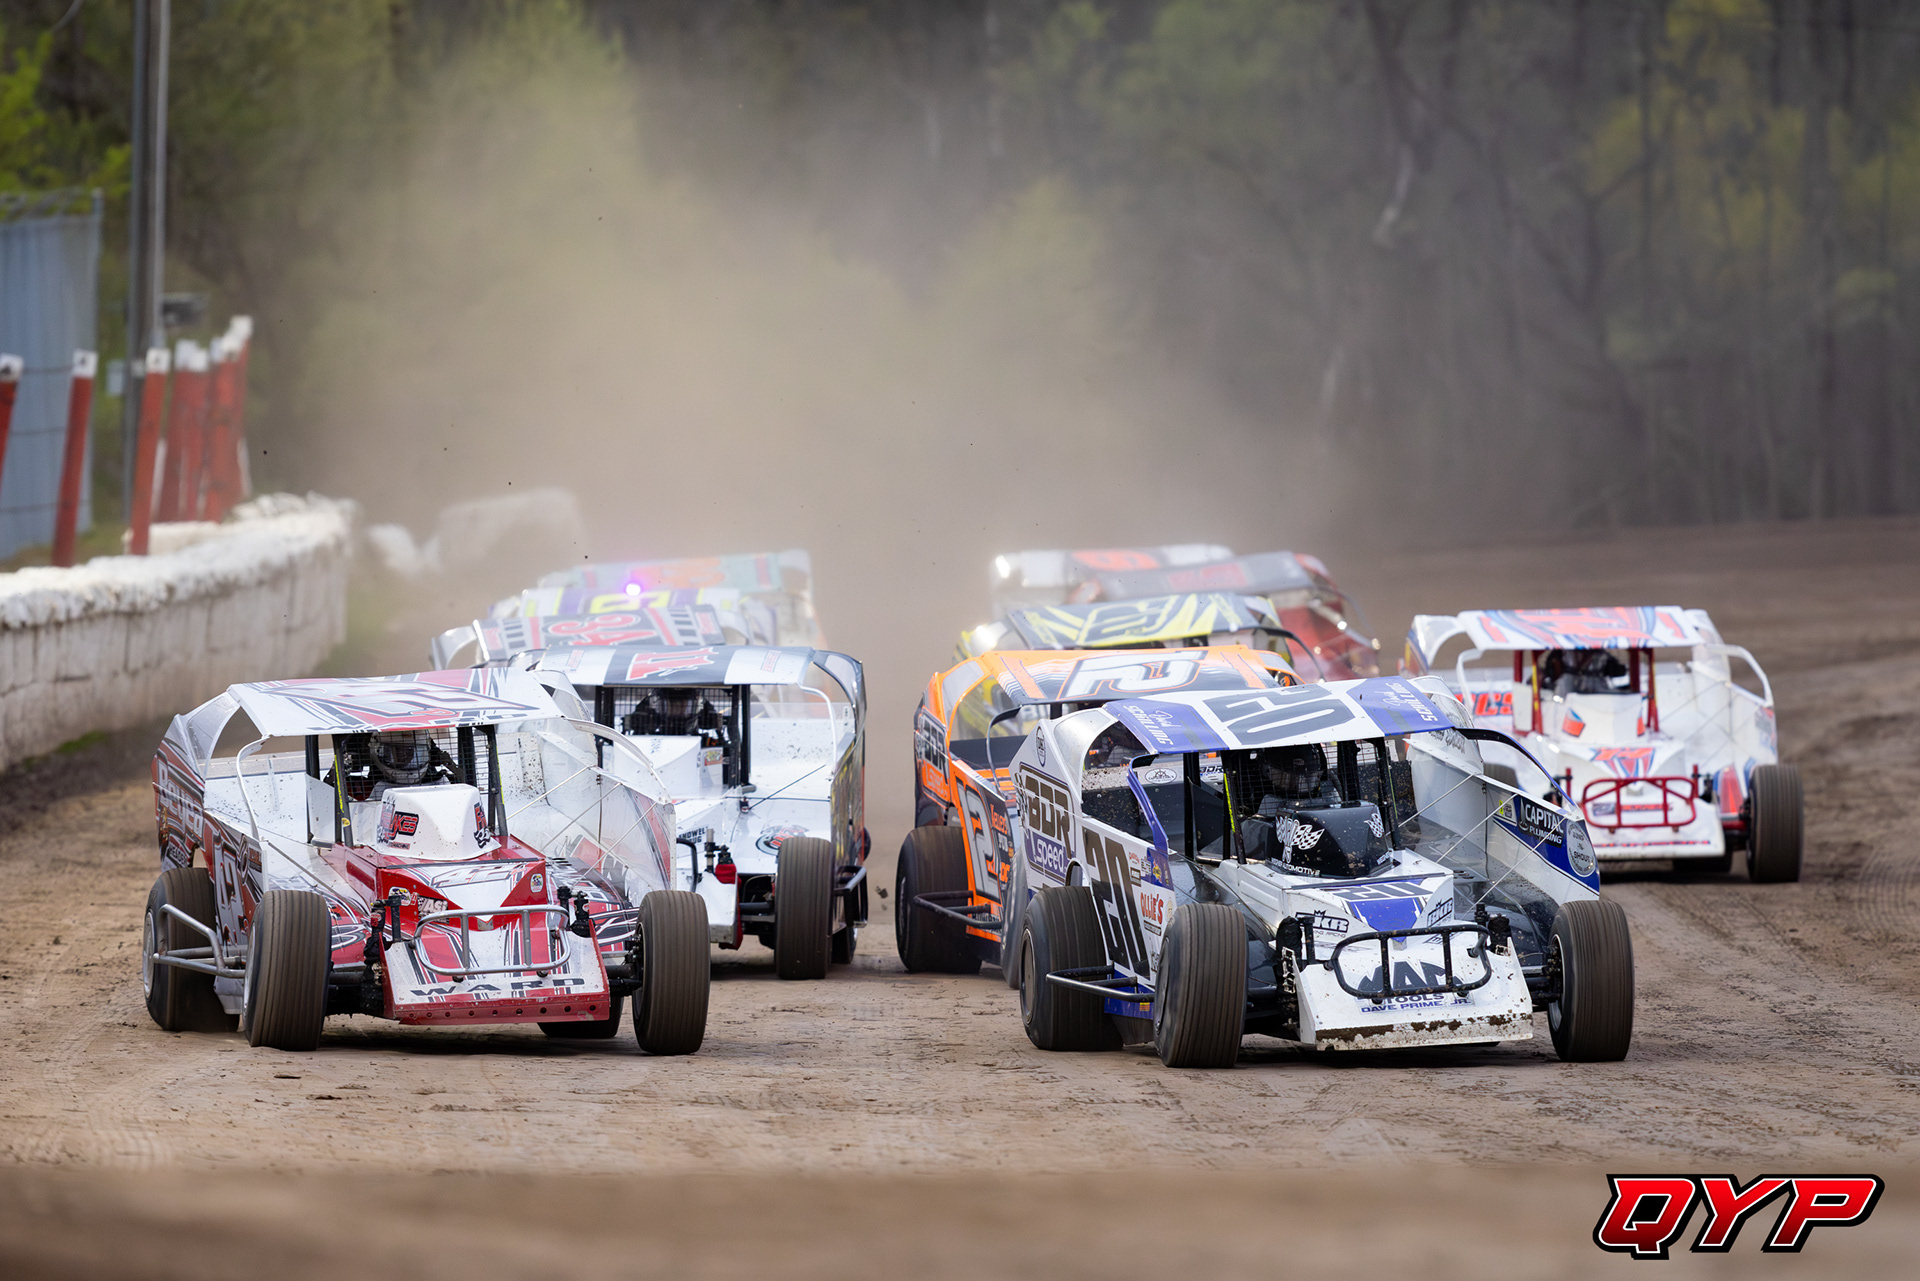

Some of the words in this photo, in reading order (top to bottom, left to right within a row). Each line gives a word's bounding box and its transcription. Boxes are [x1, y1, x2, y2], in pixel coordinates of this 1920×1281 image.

[1058, 650, 1207, 699] 12
[1202, 683, 1355, 745] 20
[1025, 774, 1072, 859] BDR
[1525, 803, 1564, 834] CAPITAL
[1082, 825, 1151, 983] 20
[1332, 881, 1434, 900] 20
[410, 978, 585, 996] WARD
[1361, 1004, 1397, 1014] DAVE
[1400, 1000, 1444, 1010] PRIME
